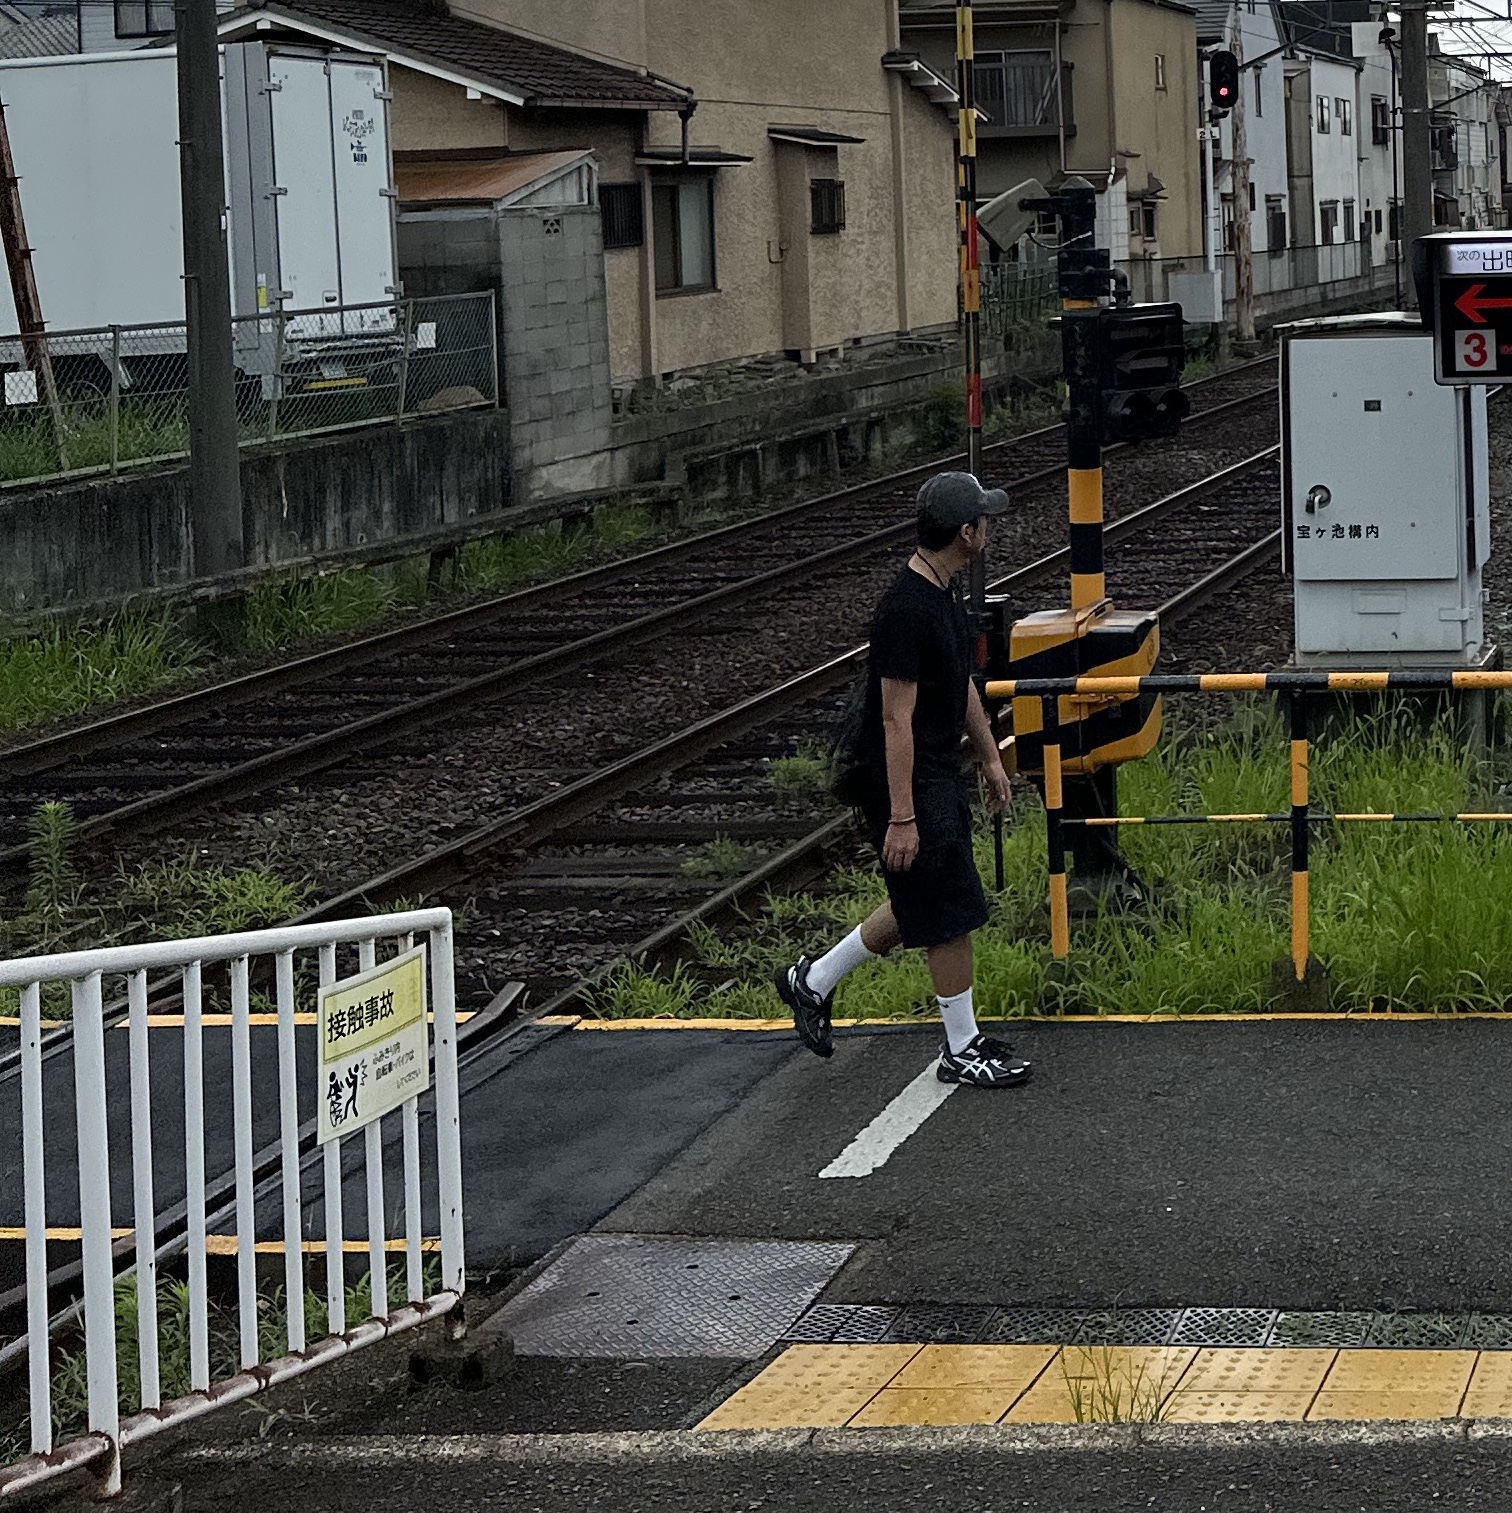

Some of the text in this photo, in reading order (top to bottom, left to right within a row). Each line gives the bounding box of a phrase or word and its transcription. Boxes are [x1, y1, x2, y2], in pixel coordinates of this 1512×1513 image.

[1463, 333, 1488, 367] 3
[1297, 523, 1379, 539] 宝ヶ池構内
[327, 989, 395, 1043] 接触事故
